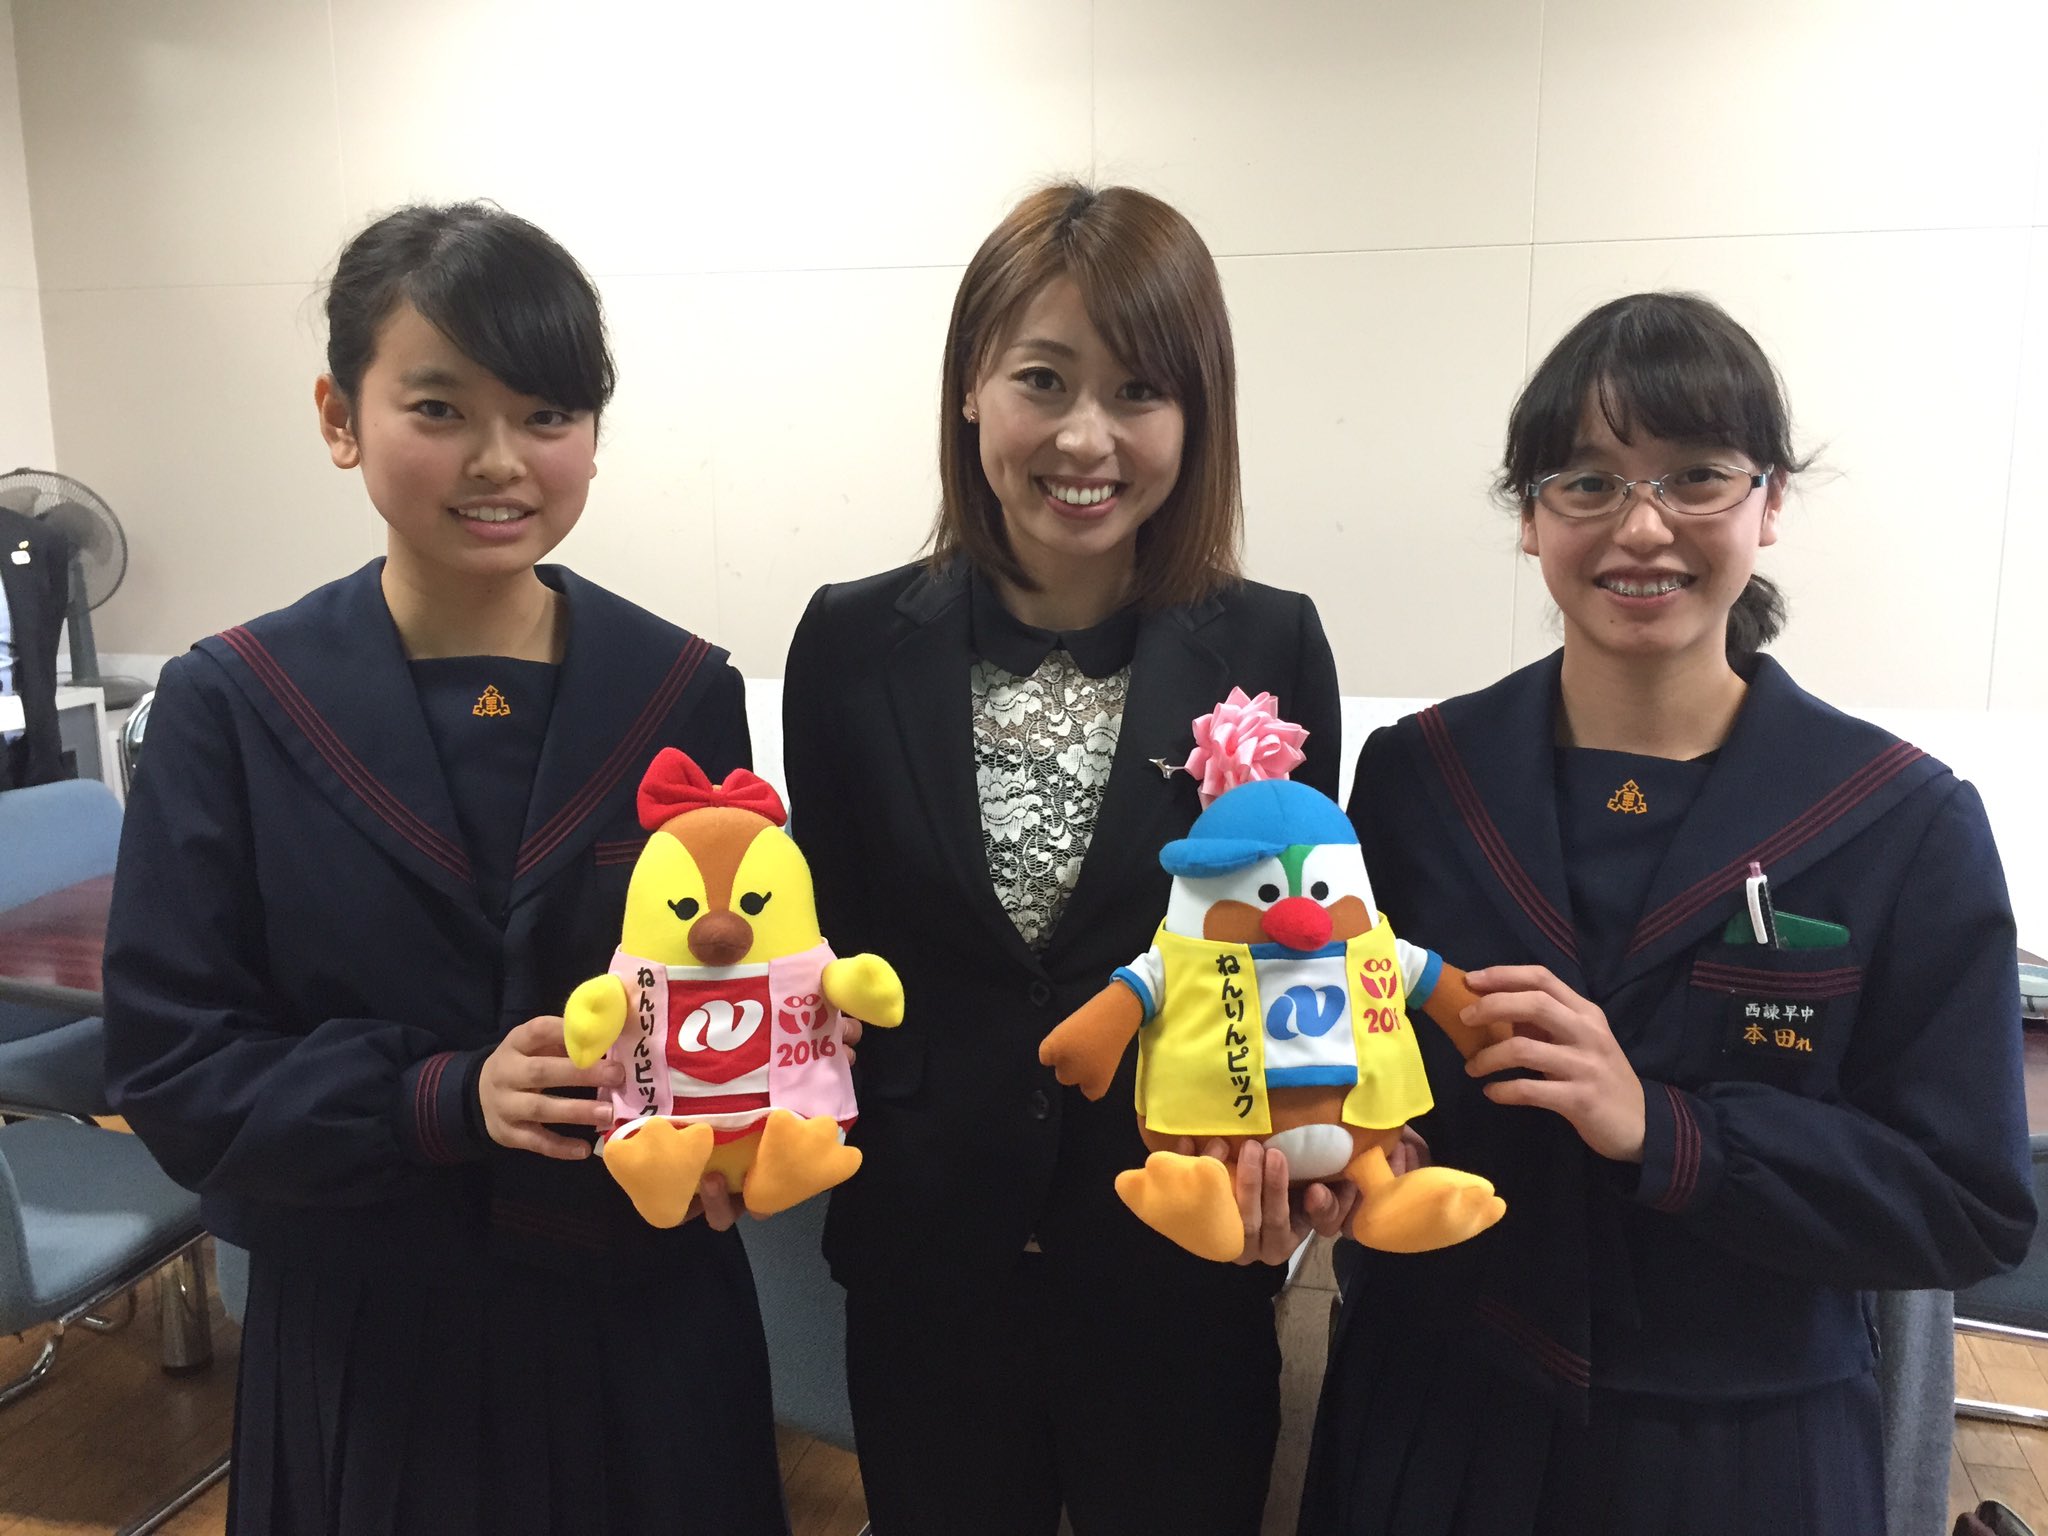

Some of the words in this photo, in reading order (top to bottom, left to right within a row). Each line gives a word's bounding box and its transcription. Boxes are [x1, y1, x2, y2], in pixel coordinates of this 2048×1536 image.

[776, 1034, 837, 1068] 2016
[1216, 953, 1254, 1119] ねんりんピック
